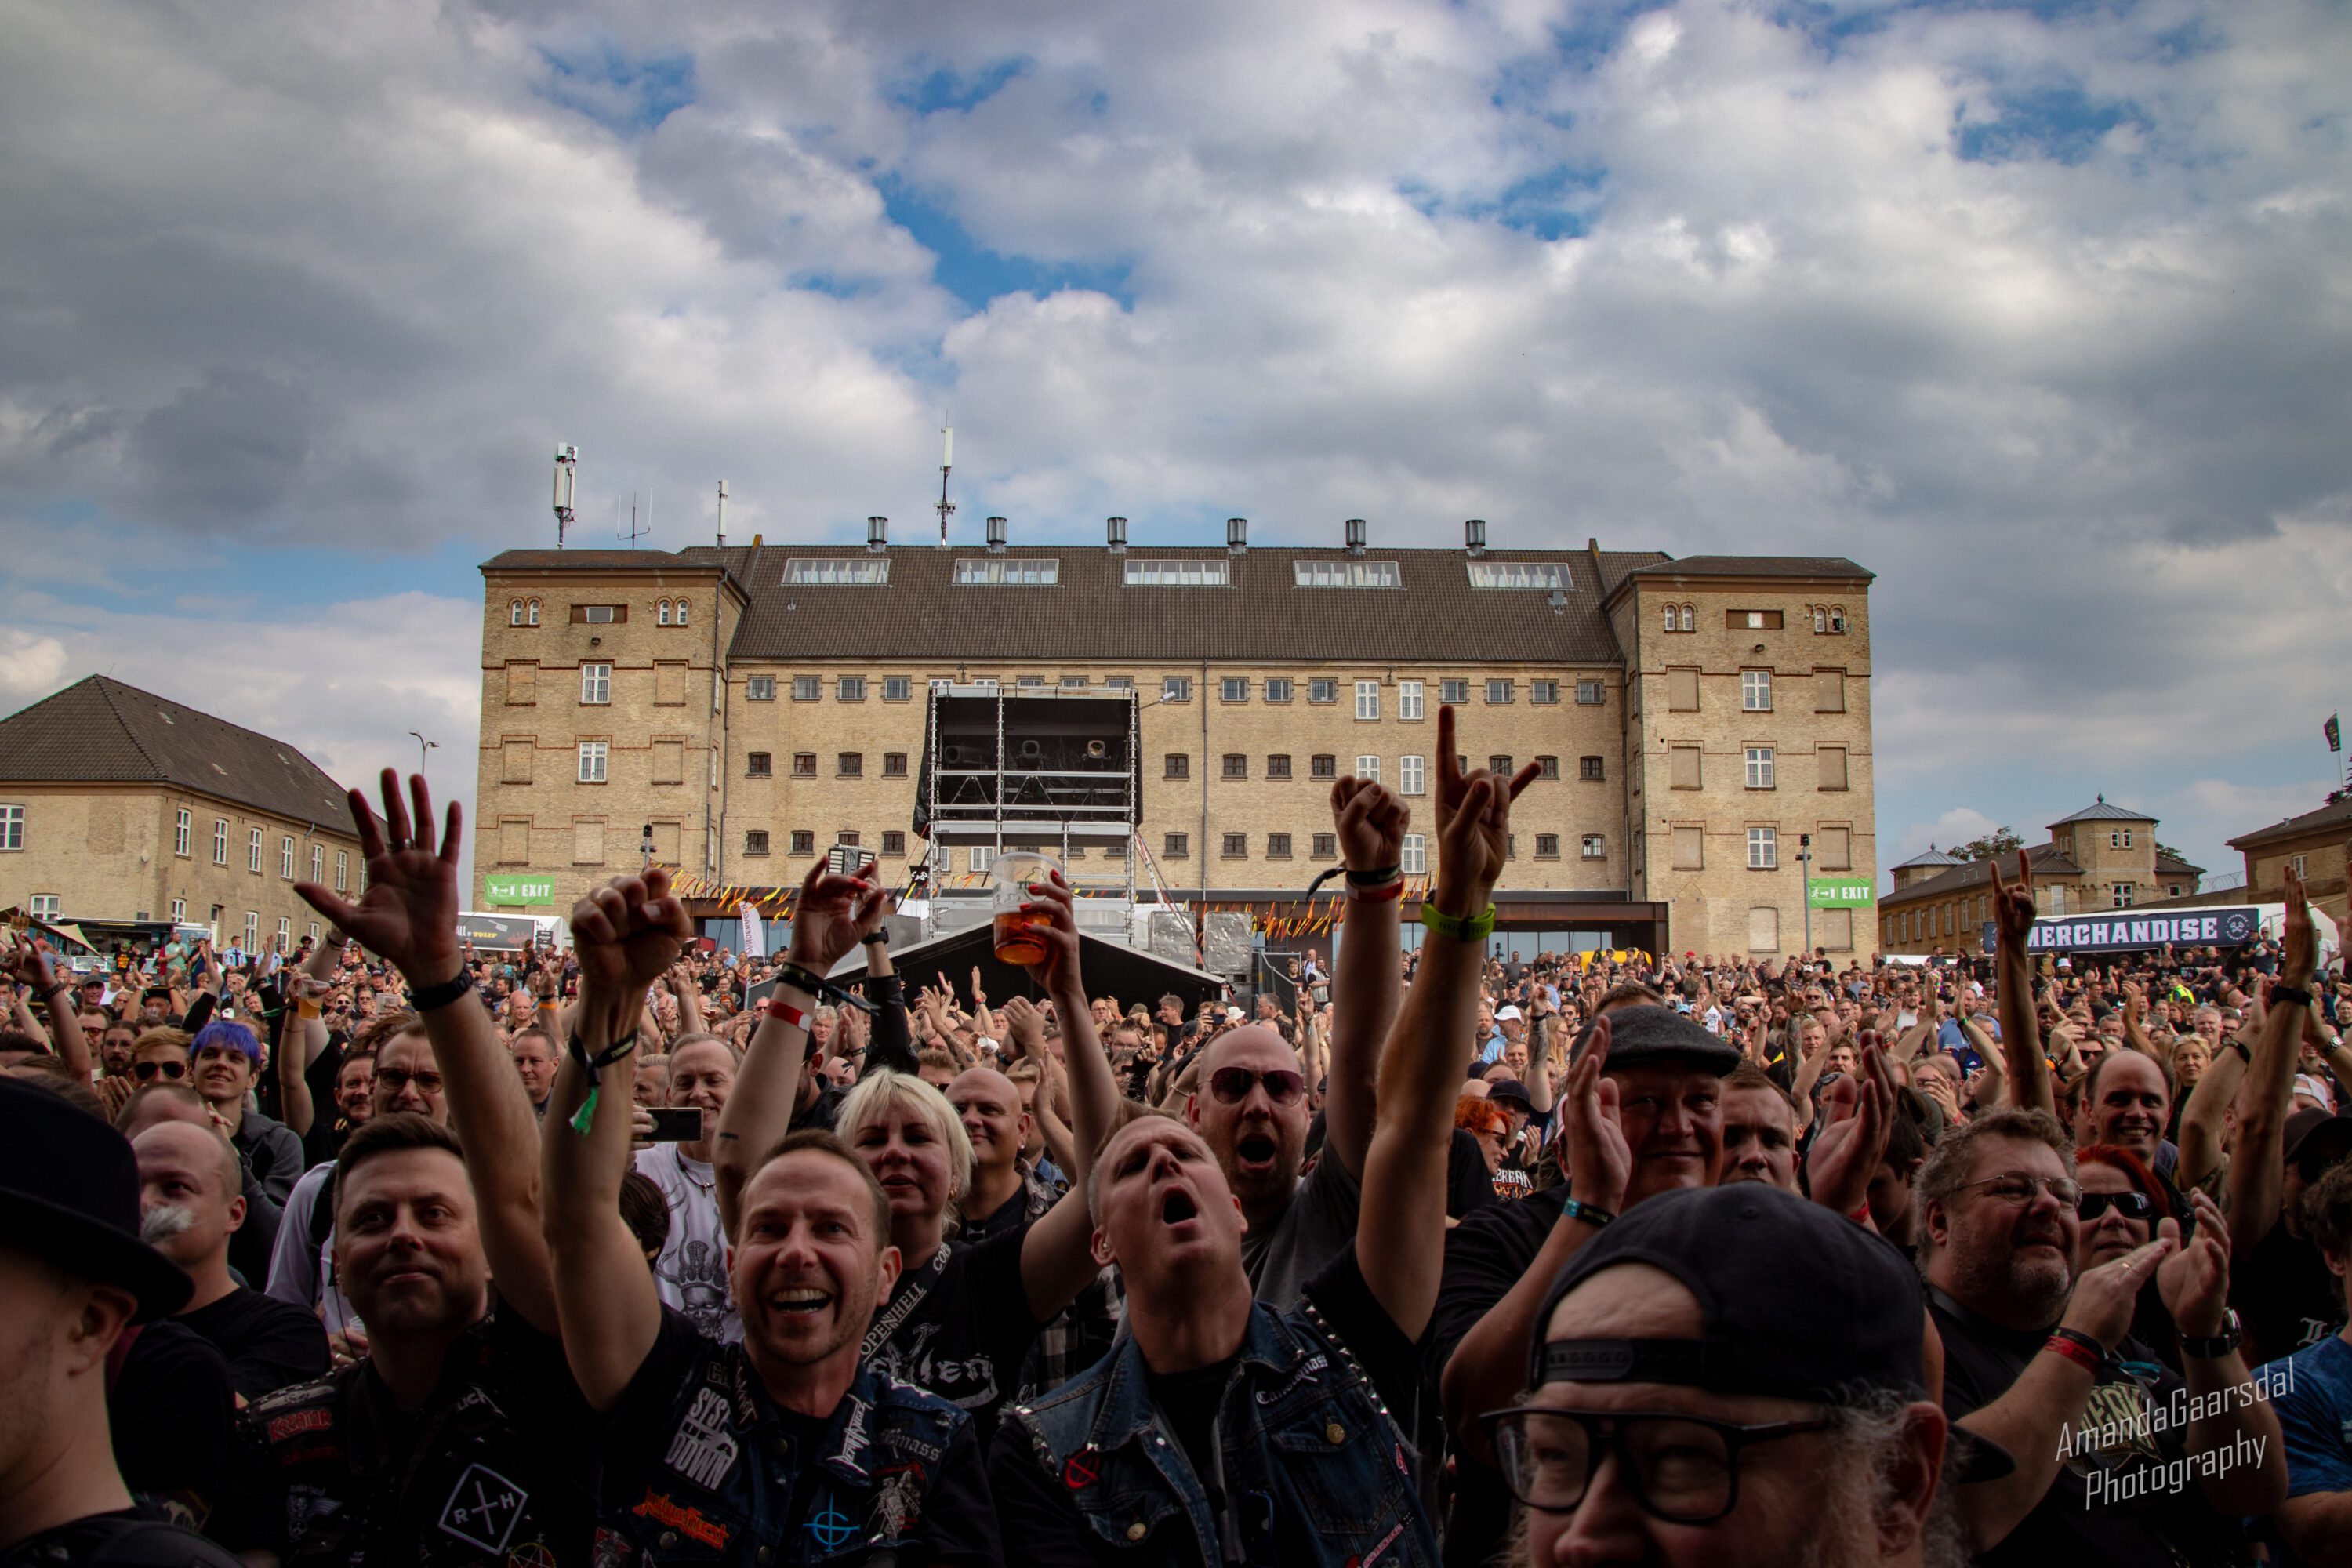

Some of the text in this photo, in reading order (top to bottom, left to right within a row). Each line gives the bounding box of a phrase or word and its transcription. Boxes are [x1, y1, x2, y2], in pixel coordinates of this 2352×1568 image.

[521, 884, 550, 897] EXIT
[1842, 887, 1869, 899] EXIT
[269, 1409, 333, 1444] KREATOR
[717, 1441, 734, 1457] A
[662, 1434, 730, 1491] DOWN
